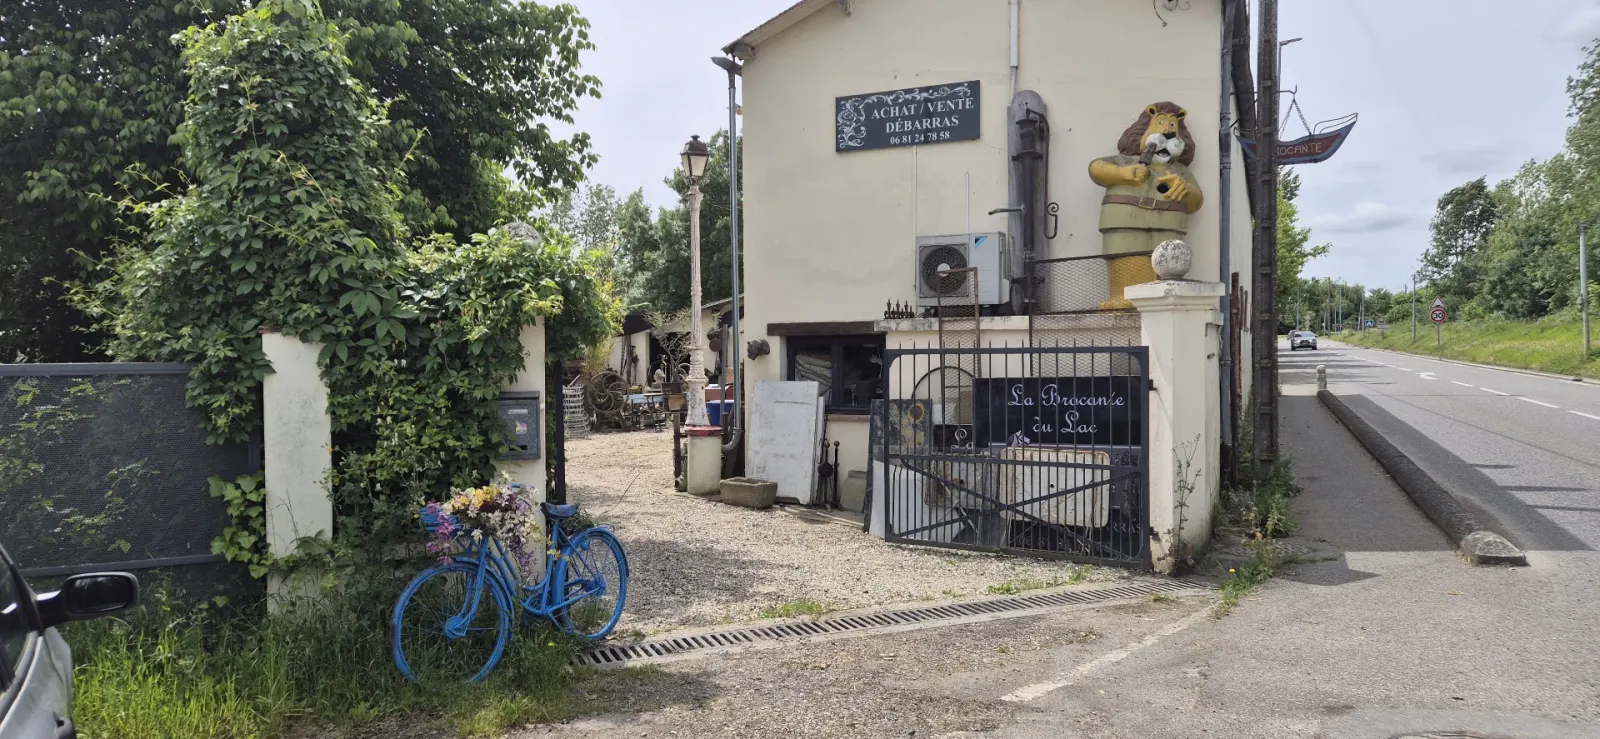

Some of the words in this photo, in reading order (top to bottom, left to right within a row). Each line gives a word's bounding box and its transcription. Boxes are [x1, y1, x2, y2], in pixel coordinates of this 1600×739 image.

[871, 104, 918, 119] ACHAT
[927, 97, 974, 113] VENTE
[885, 115, 960, 134] DÉBARRAS
[890, 135, 900, 145] 06
[902, 134, 912, 144] 81
[914, 133, 925, 143] 24
[927, 132, 938, 141] 78
[939, 131, 950, 140] 58
[1277, 142, 1322, 156] ROCANTE
[1008, 383, 1035, 406] La
[1032, 416, 1054, 433] du
[1060, 410, 1098, 433] Lac
